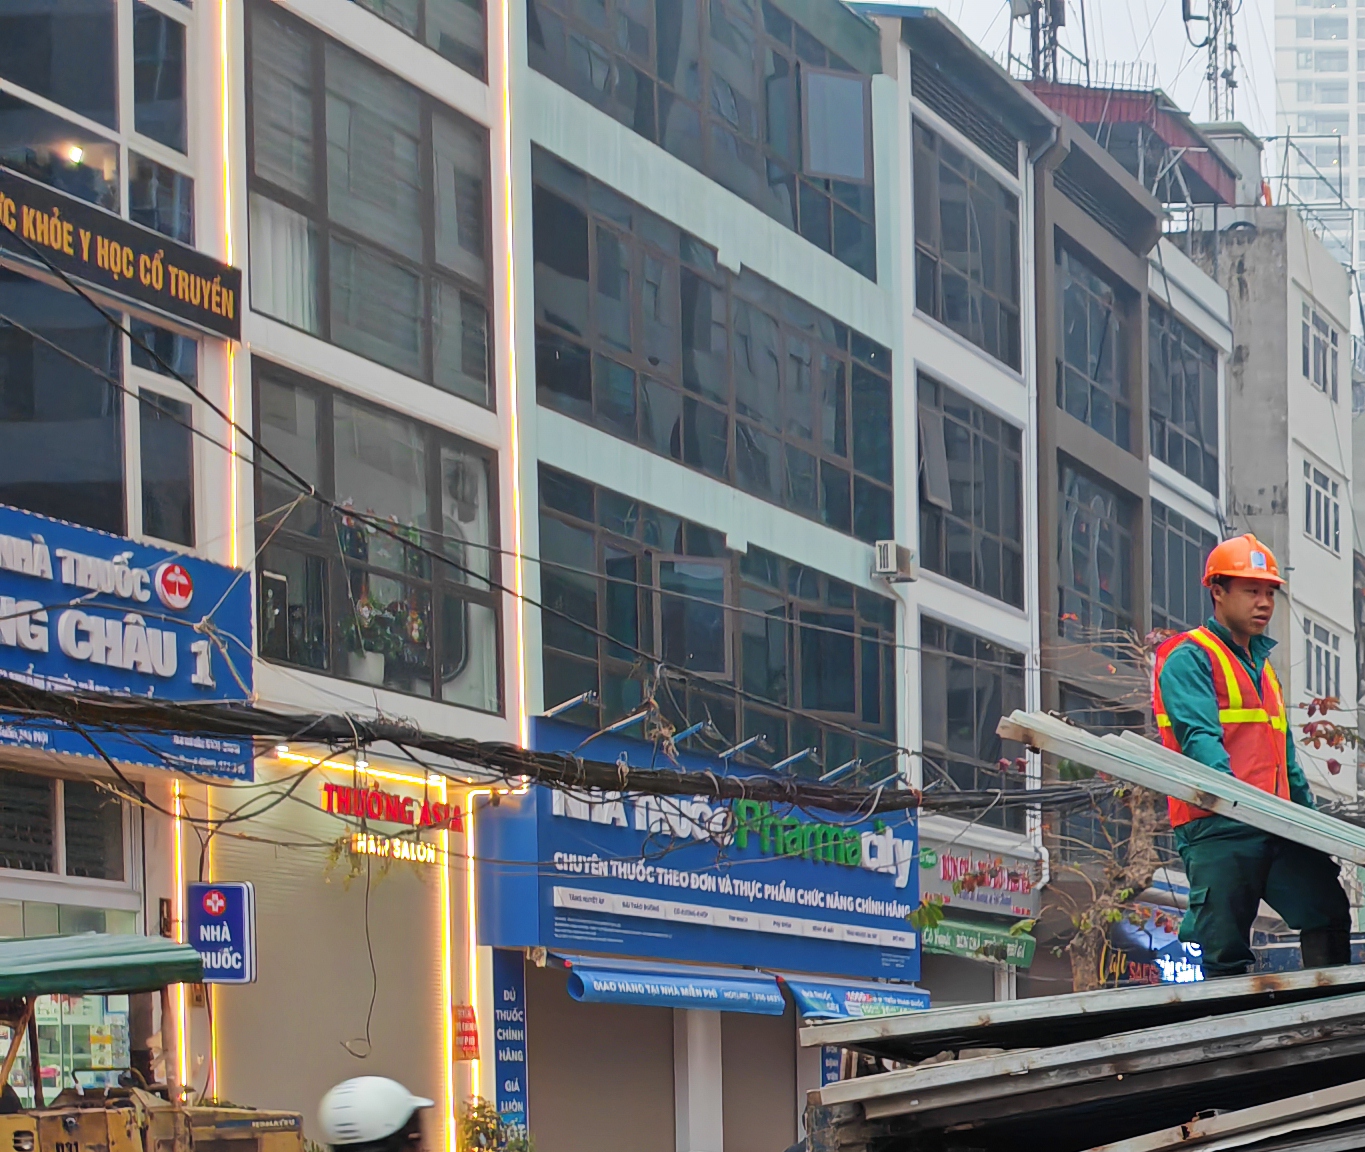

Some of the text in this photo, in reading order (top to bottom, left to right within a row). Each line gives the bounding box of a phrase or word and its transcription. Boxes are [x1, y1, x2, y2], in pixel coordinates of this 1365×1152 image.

[22, 204, 74, 256] KHỎE
[79, 228, 91, 262] Y
[96, 235, 134, 280] HỌC
[139, 249, 164, 291] CỔ
[0, 533, 151, 603] NHÀ THUỐC
[58, 608, 178, 678] CHÂU
[191, 640, 216, 690] 1
[554, 852, 608, 877] CHUYÊN
[610, 858, 655, 883] THUỐC
[656, 867, 689, 887] THEO
[690, 872, 717, 892] ĐƠN
[717, 874, 733, 896] VÀ
[732, 879, 763, 902] THỰC
[200, 921, 231, 942] NHÀ
[202, 946, 242, 970] HUỐC
[495, 1007, 524, 1022] THUỐC
[496, 1026, 524, 1041] CHÍNH
[504, 1077, 520, 1092] GIÁ
